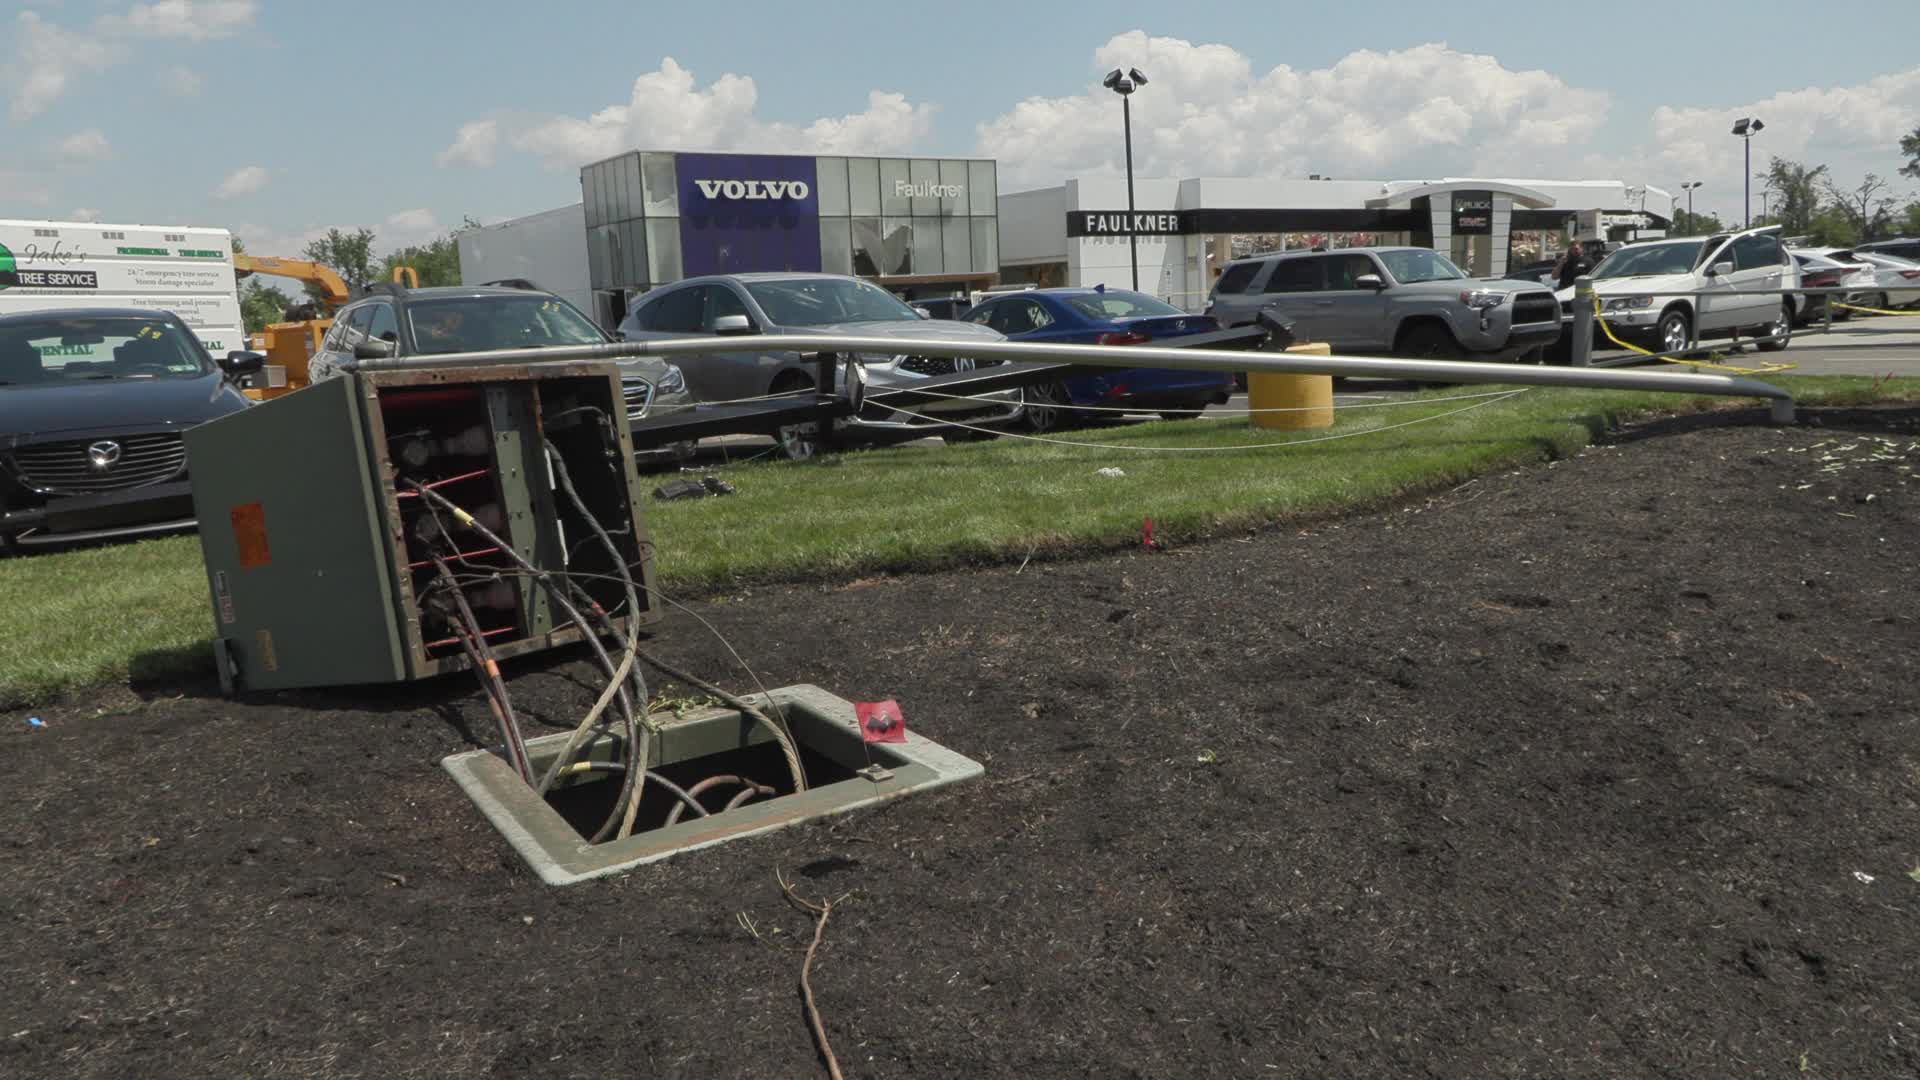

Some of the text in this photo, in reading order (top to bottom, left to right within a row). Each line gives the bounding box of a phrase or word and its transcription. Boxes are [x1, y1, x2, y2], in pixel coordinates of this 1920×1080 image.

[695, 180, 809, 200] VOLVO
[895, 180, 964, 198] Faulkner
[1086, 215, 1178, 232] FAULKNER
[24, 240, 87, 265] Jake's
[17, 272, 96, 286] TREE SERVICE
